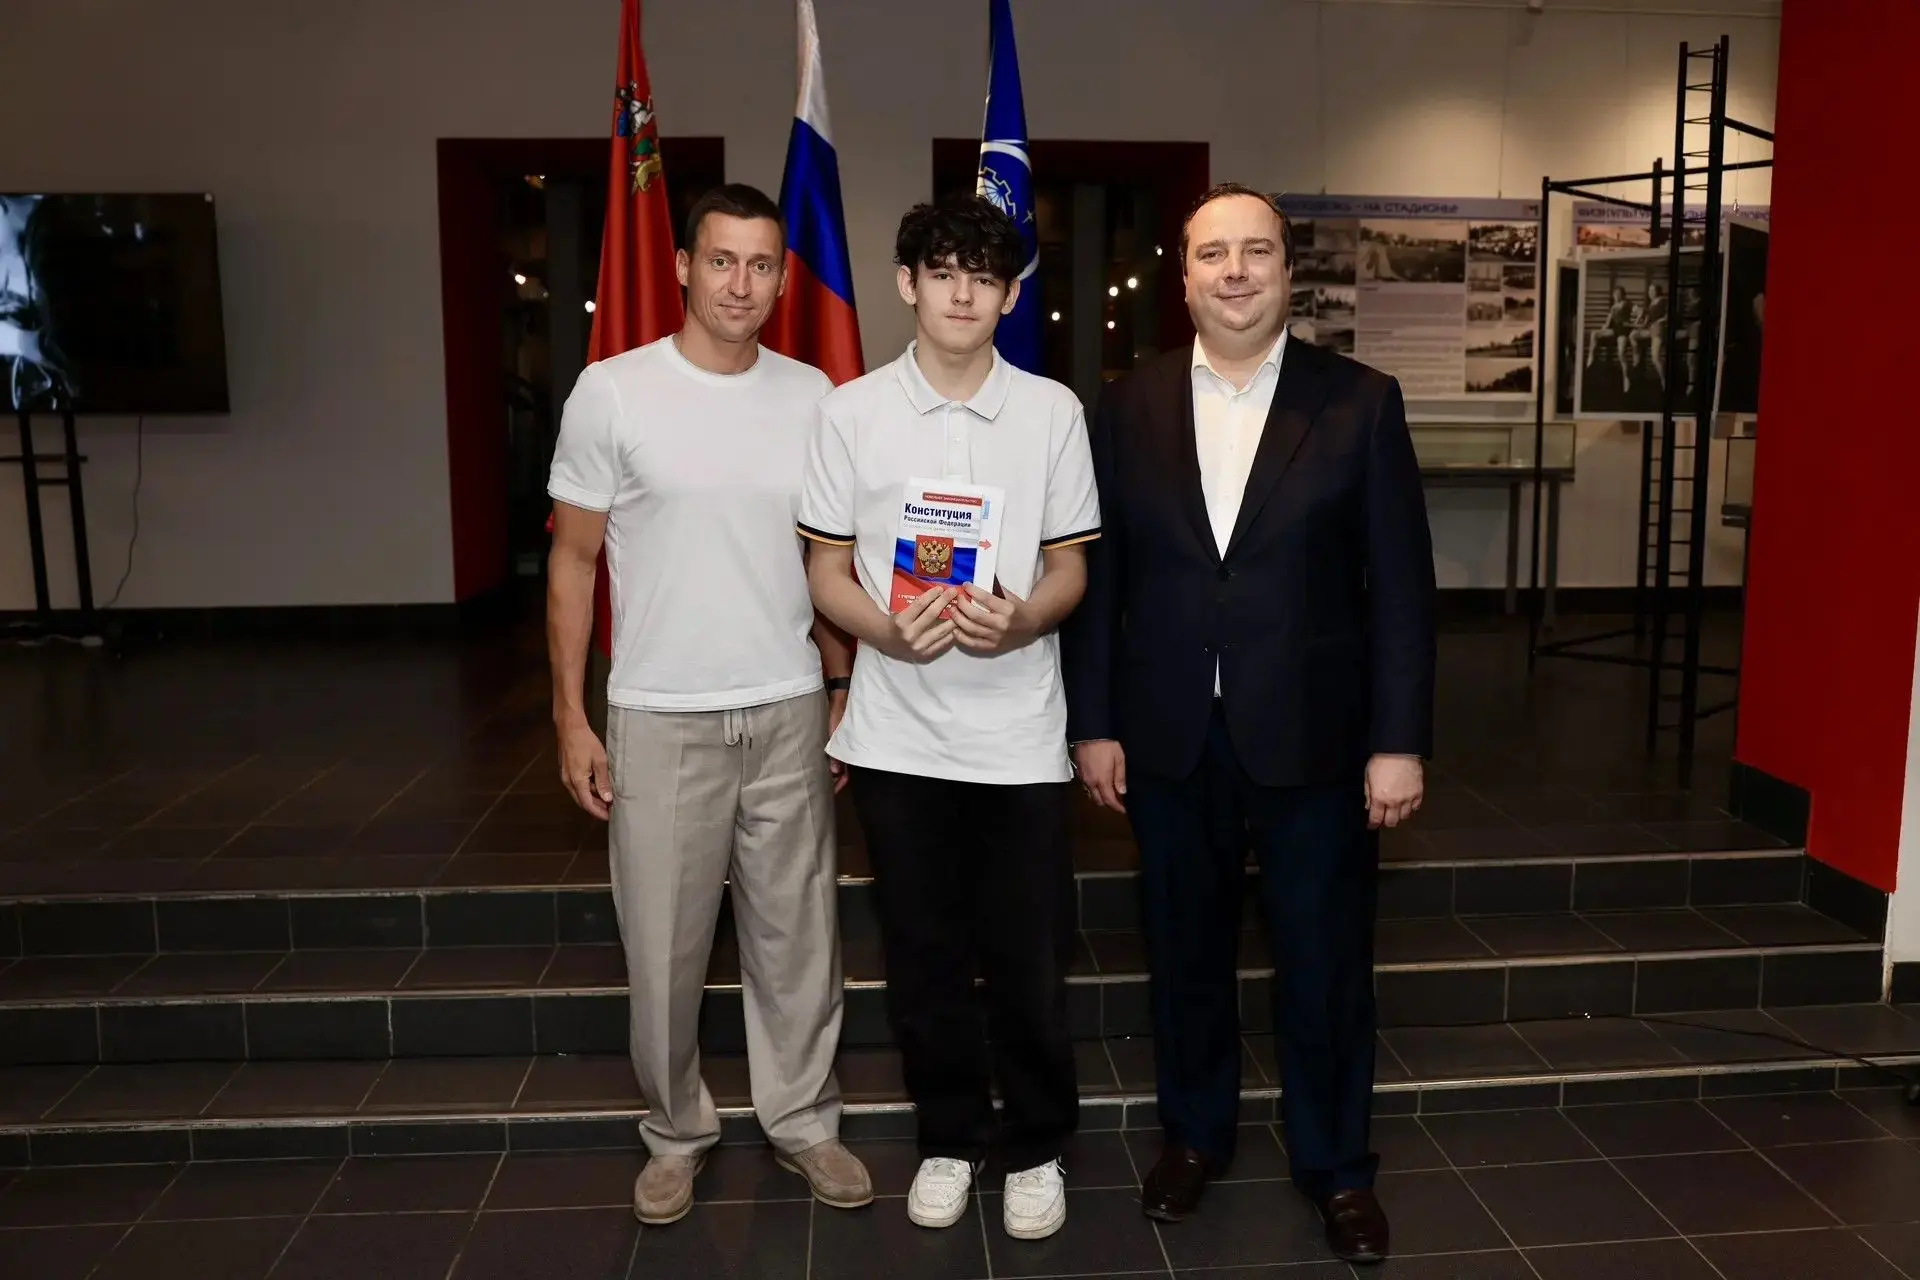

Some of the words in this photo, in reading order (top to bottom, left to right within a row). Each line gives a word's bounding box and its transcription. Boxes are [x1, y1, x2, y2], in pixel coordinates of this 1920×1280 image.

[904, 502, 972, 520] Конституция
[903, 514, 937, 525] Российской
[938, 519, 971, 528] Федерации
